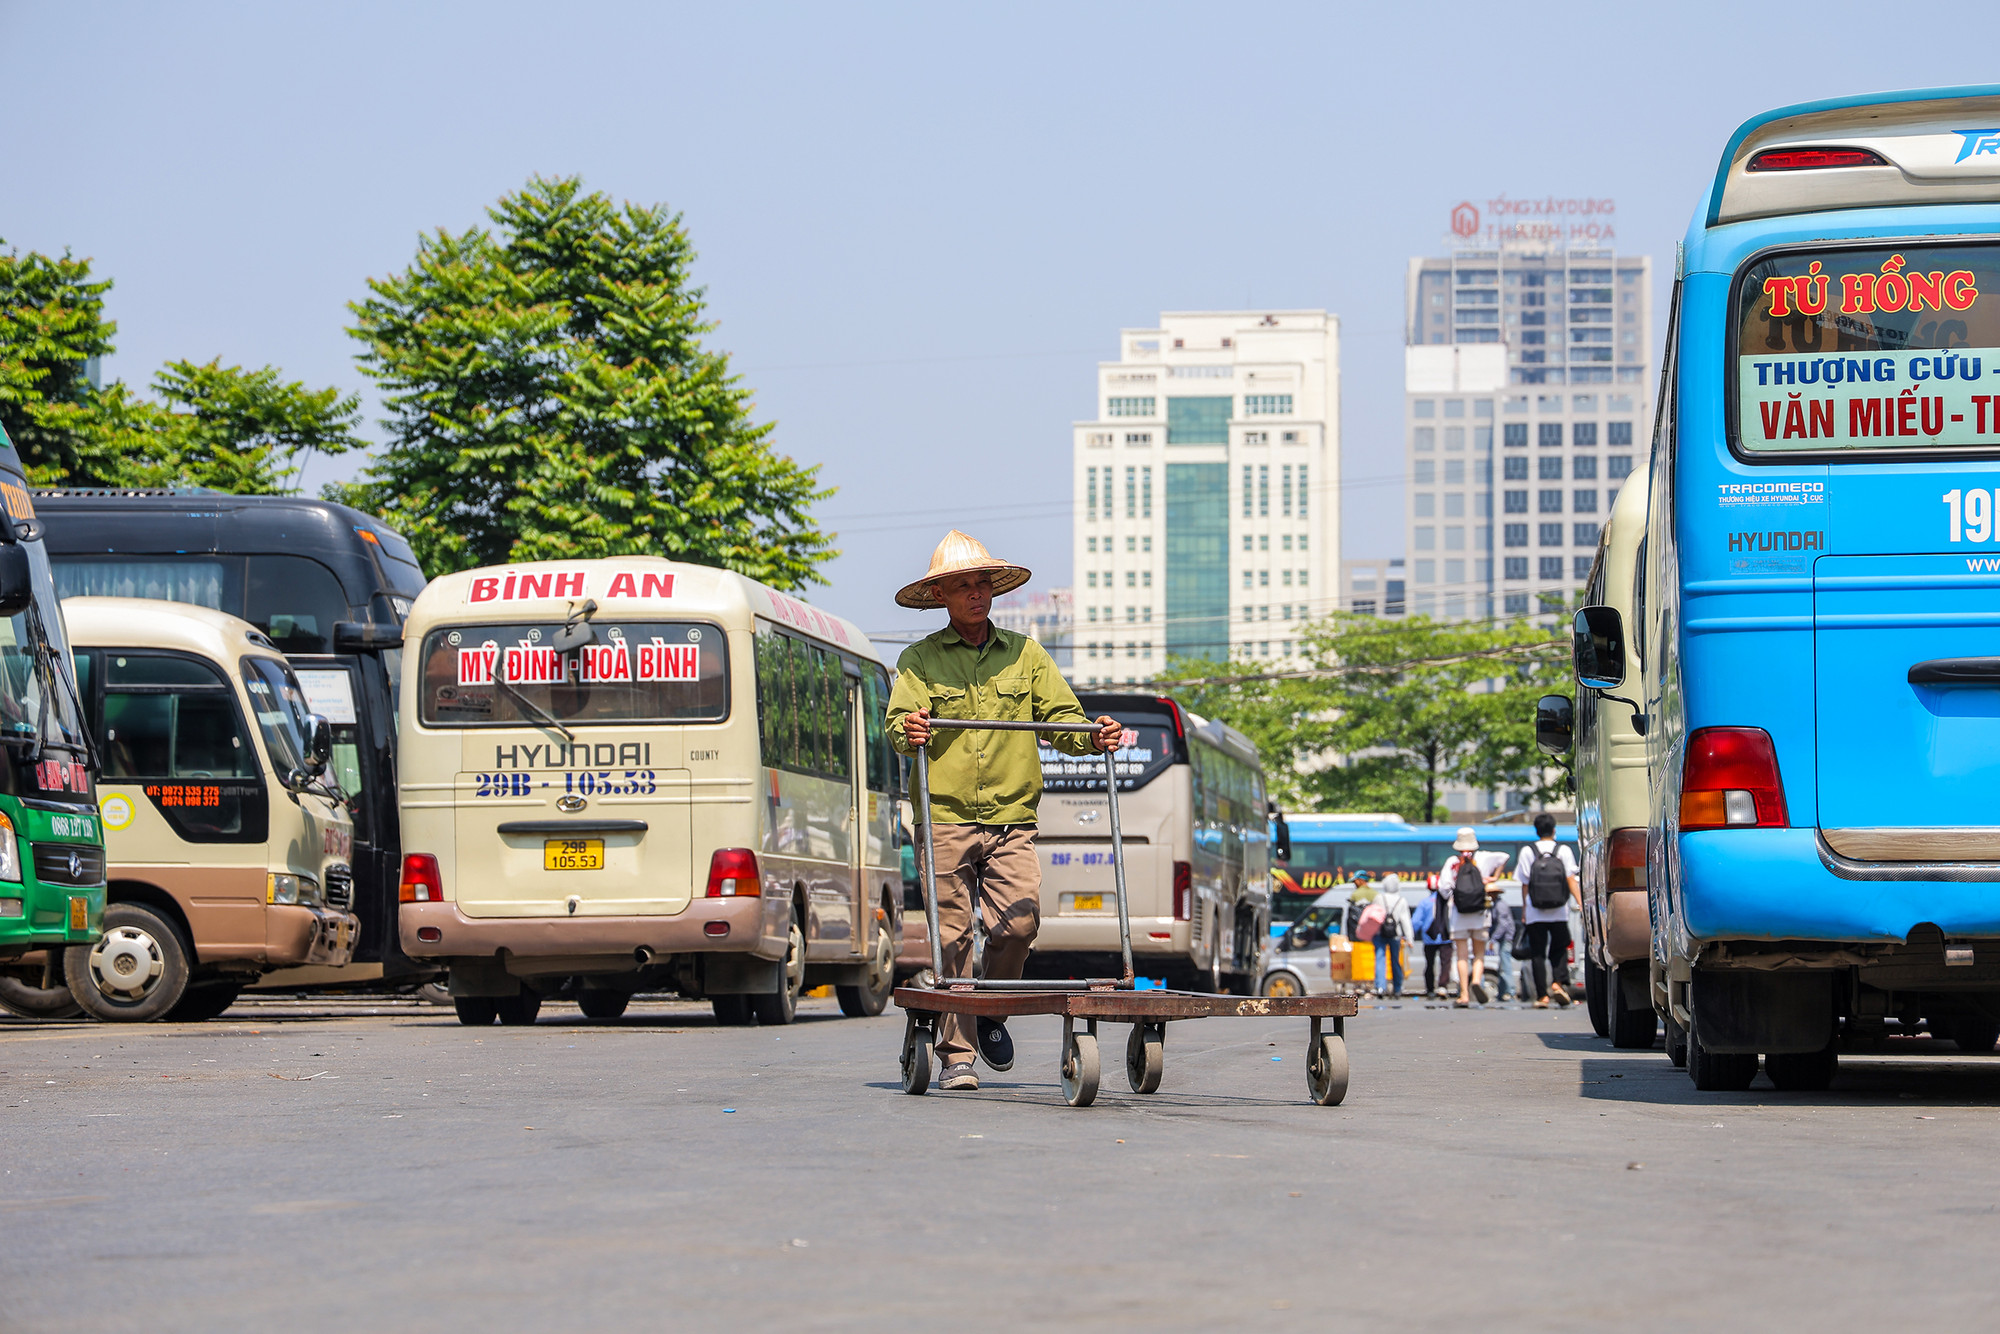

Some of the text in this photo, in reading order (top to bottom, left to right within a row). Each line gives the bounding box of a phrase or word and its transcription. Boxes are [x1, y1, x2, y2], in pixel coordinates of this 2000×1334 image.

[1763, 253, 1979, 317] TÚ HỒNG
[1753, 348, 1981, 389] THƯỢNG CỬU
[1759, 392, 1835, 440] VĂN
[1849, 384, 1943, 437] MIẾU
[1971, 395, 2000, 434] T
[1718, 482, 1824, 494] TRACOMECO
[1801, 493, 1808, 505] 3
[1942, 488, 2000, 543] 19
[1728, 531, 1824, 552] HYUNDAI
[470, 571, 675, 603] BÌNH AN
[461, 643, 496, 682] MỸ
[507, 642, 563, 681] ĐÌNH
[583, 640, 629, 680] HOÀ
[640, 640, 697, 678] BÌNH
[496, 742, 720, 769] HYUNDAI COUNTY
[162, 785, 184, 796] 0973
[475, 772, 532, 797] 29B
[563, 770, 656, 796] 105.53
[561, 841, 587, 855] 29B
[552, 856, 597, 869] 105.53
